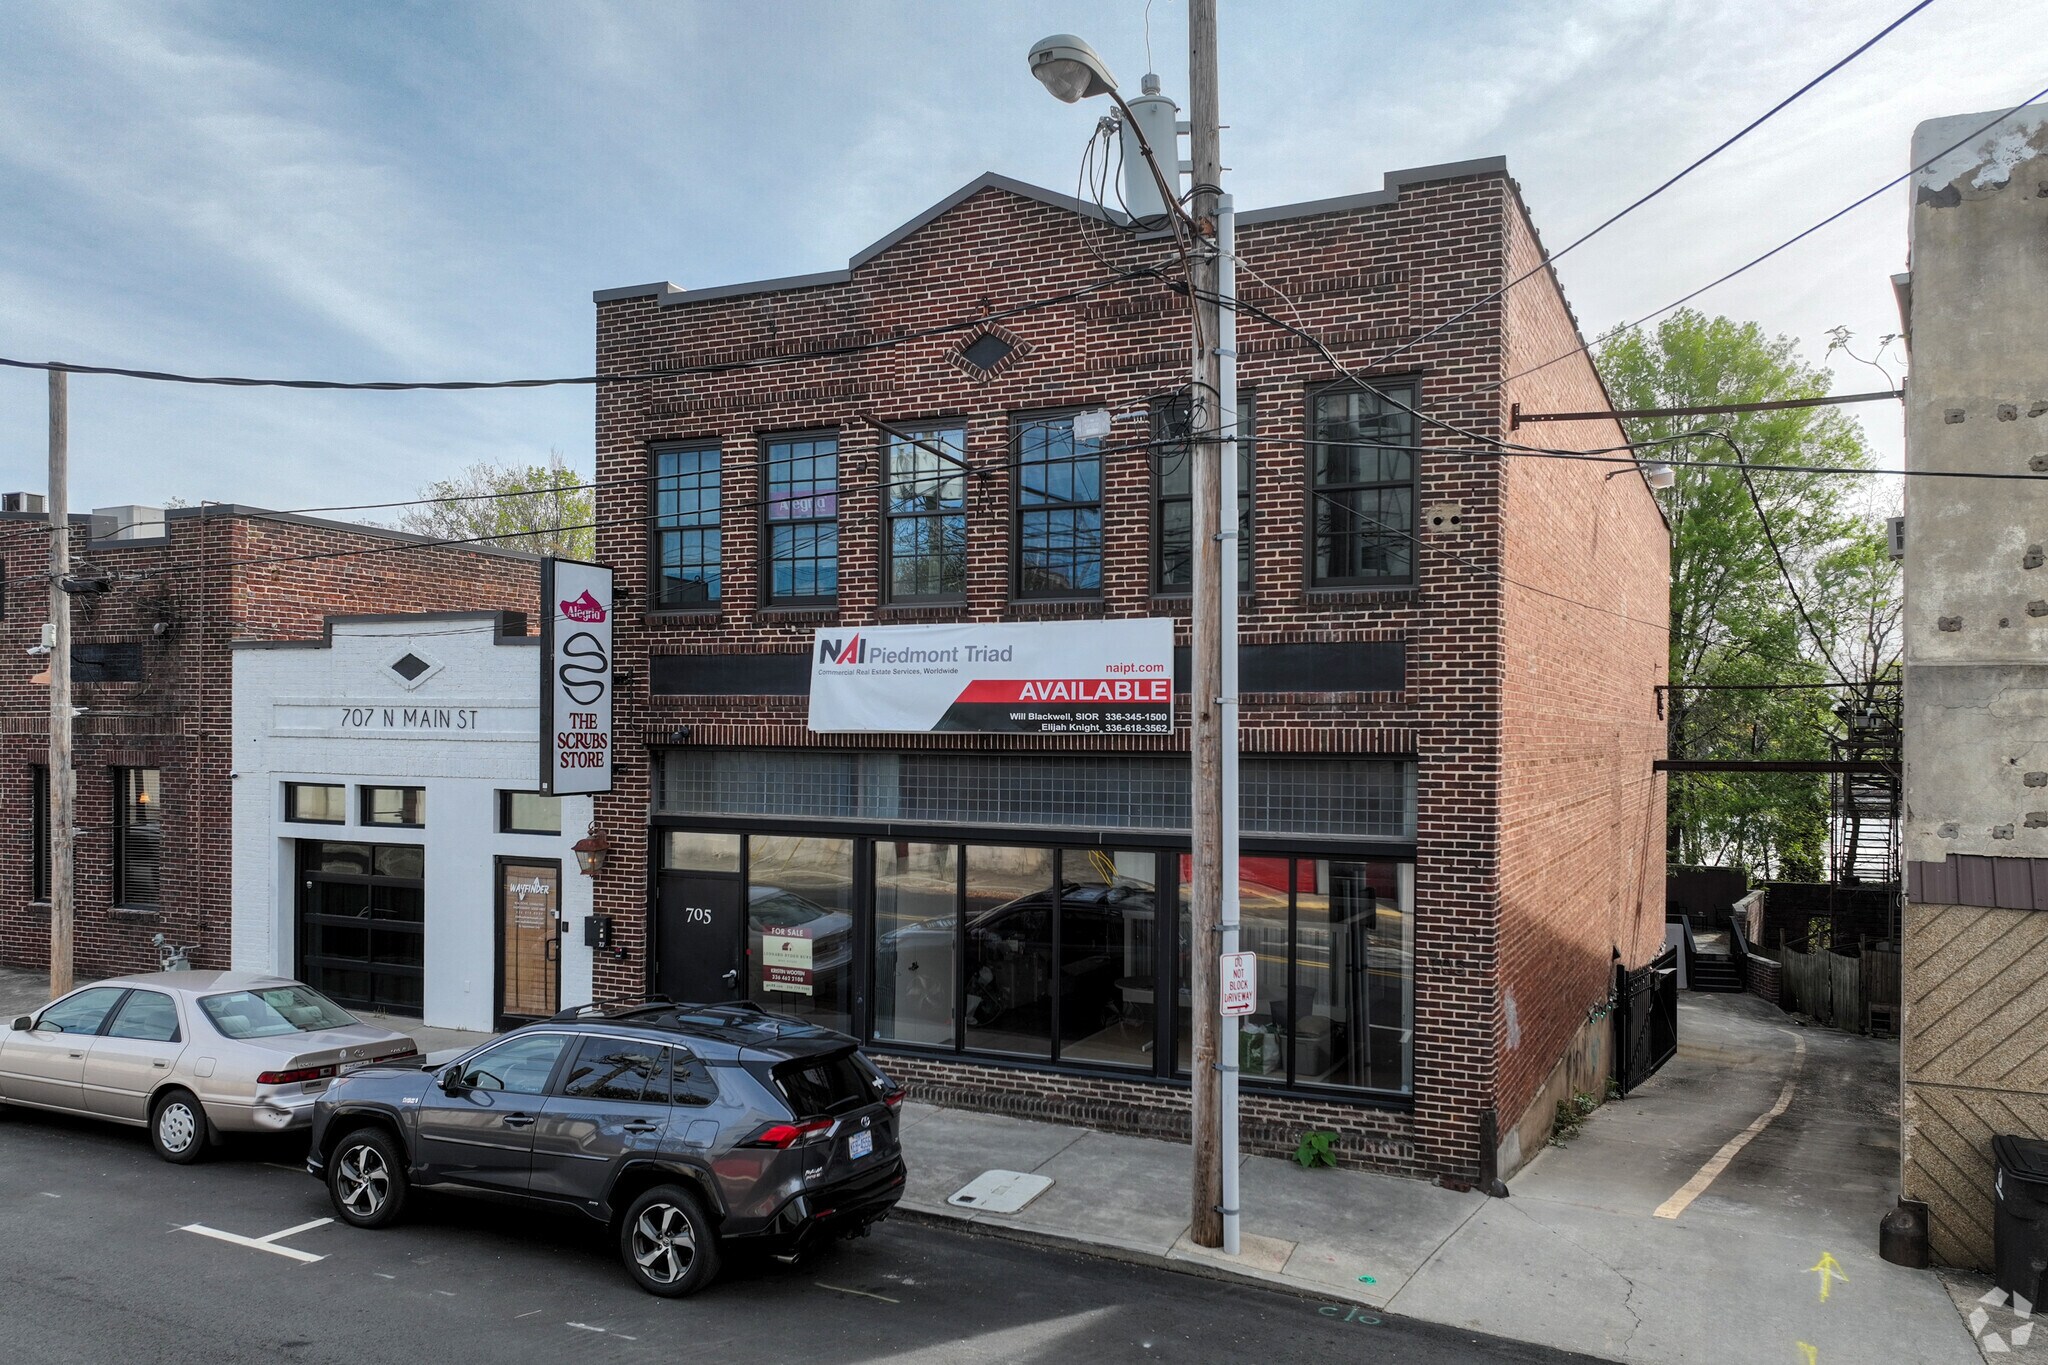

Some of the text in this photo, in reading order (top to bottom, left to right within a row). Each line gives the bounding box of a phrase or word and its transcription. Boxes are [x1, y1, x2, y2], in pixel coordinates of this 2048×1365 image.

[780, 497, 826, 512] Aegra
[567, 605, 600, 622] Alegria
[819, 632, 1012, 665] NAI Piedmont Triad
[818, 668, 855, 676] Commercial
[892, 668, 922, 676] Services,
[923, 667, 958, 675] Worldwide
[1105, 663, 1164, 675] naipt.com
[1018, 681, 1168, 701] AVAILABLE
[341, 708, 478, 729] 707 N MAIN ST
[568, 712, 599, 730] THE
[1028, 713, 1073, 721] Blackwell,
[1105, 713, 1168, 721] 336-345-1500
[1041, 723, 1168, 732] Elijah Knight 336-618-3562
[557, 731, 608, 750] SCRUBS
[560, 751, 604, 769] STORE
[510, 879, 550, 897] WAYFINDER
[685, 907, 712, 925] 705
[771, 927, 804, 937] FOR SALE
[1234, 957, 1243, 967] DO
[1233, 968, 1244, 979] NOT
[1229, 980, 1249, 991] BLOCK
[1224, 991, 1253, 1003] DRIVEWAY
